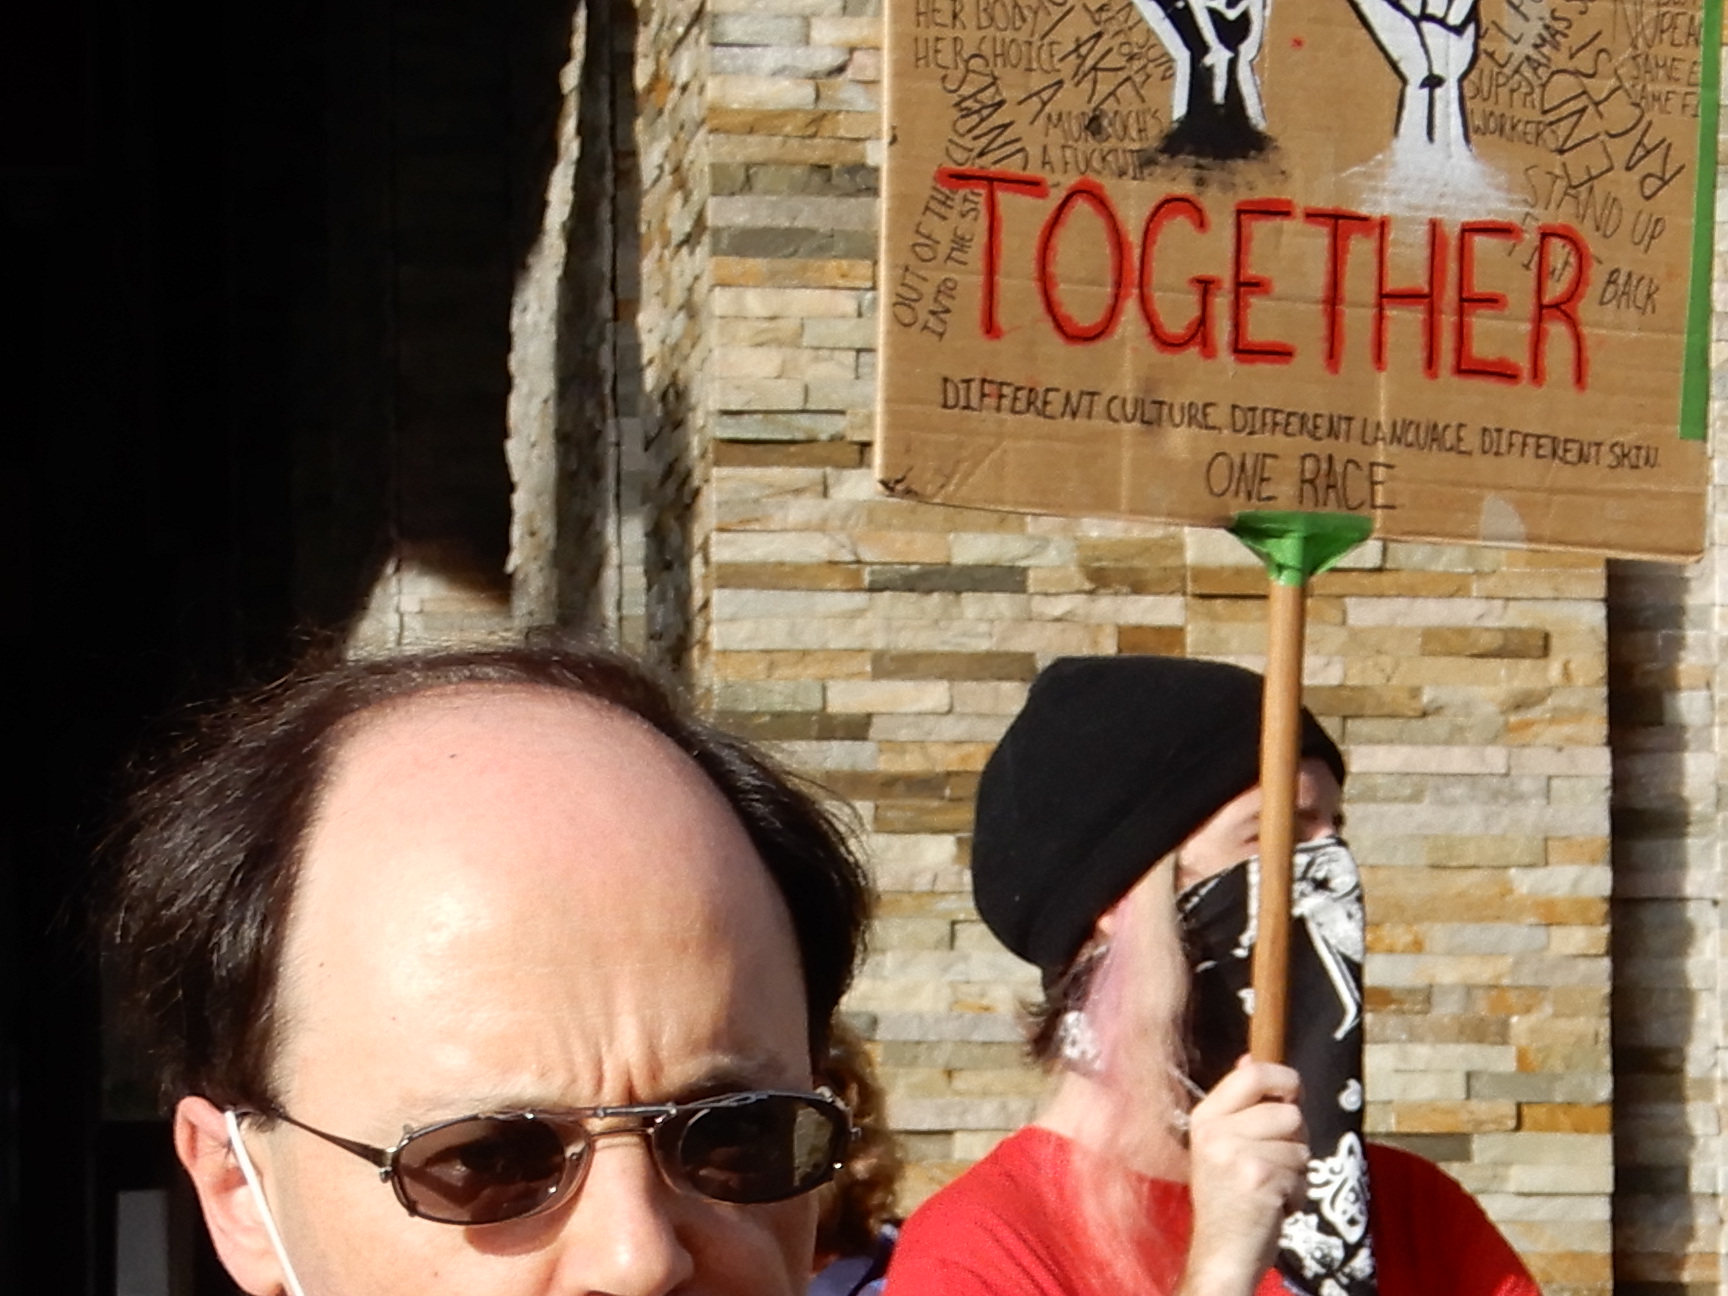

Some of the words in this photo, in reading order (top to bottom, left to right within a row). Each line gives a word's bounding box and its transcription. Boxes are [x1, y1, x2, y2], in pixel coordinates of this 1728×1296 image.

[914, 36, 965, 70] HER
[1657, 10, 1702, 48] PEA
[1040, 144, 1056, 175] A
[921, 178, 959, 222] TH
[1522, 164, 1624, 240] STAND
[1630, 208, 1667, 255] UP
[911, 221, 942, 264] OF
[891, 264, 929, 328] OUT
[919, 276, 958, 343] INTO
[944, 225, 975, 267] THE
[935, 167, 1591, 393] TOGETHER
[1599, 266, 1662, 316] BACK
[940, 375, 1102, 421] DIFFERENT
[1230, 403, 1355, 444] DIFFERENT
[1480, 425, 1603, 469] DIFFERENT
[1205, 450, 1280, 503] ONE
[1297, 452, 1399, 512] RACE
